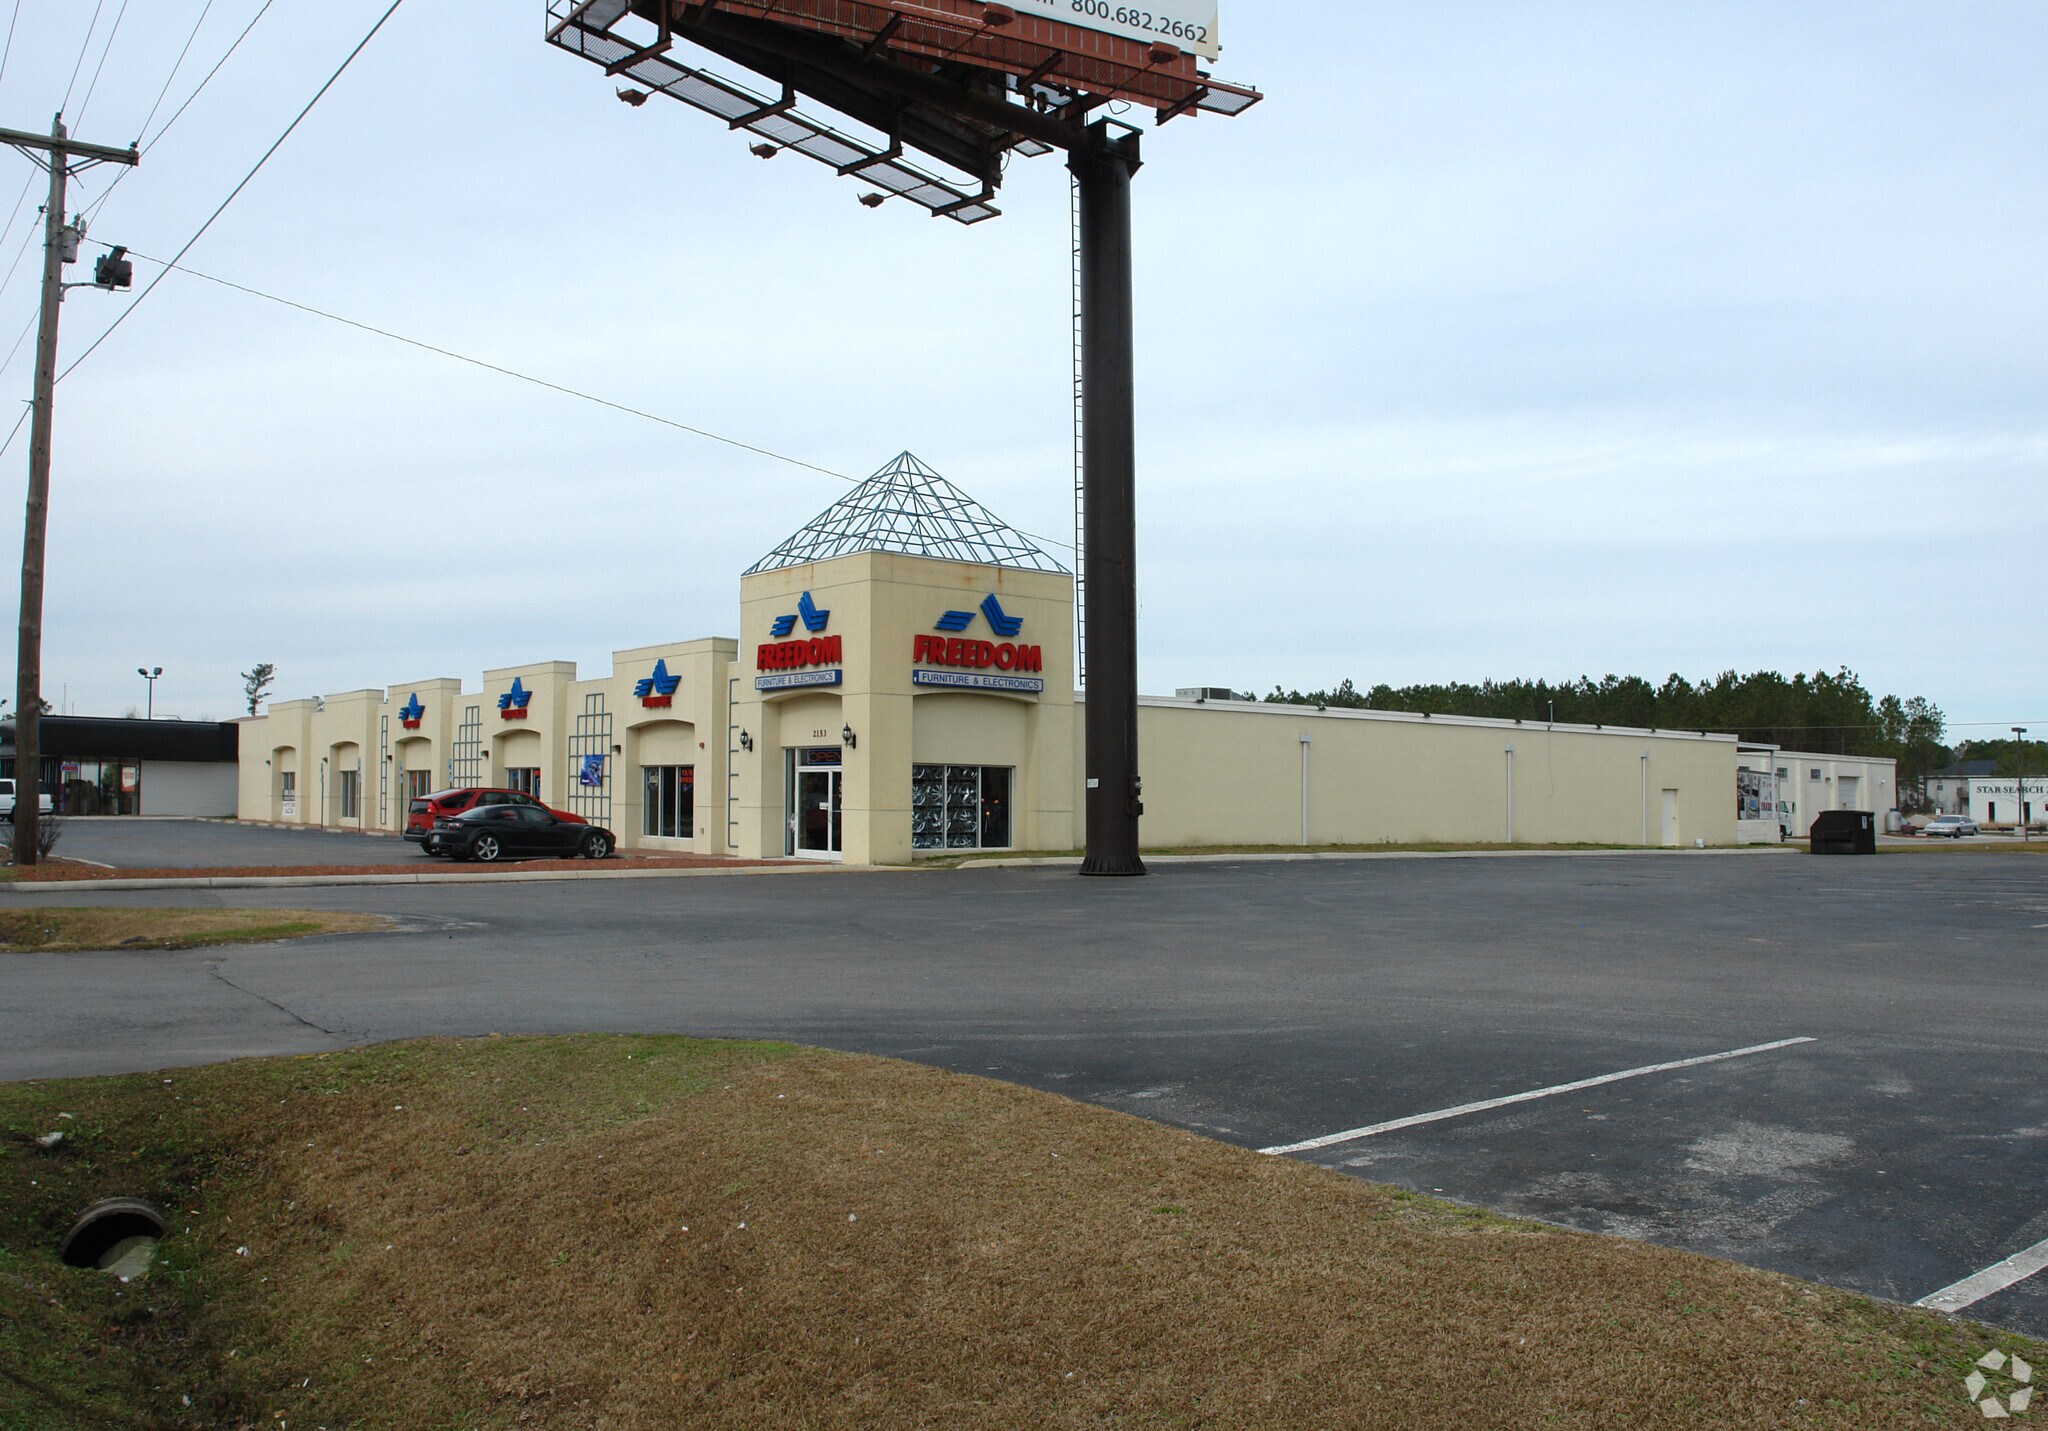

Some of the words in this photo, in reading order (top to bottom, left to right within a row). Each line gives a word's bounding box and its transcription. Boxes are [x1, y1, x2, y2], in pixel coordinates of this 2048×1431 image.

[1071, 0, 1208, 44] 800.682.2662
[757, 635, 842, 671] FREEDOM
[913, 634, 1042, 672] FREEDOM
[757, 676, 786, 688] FURNITURE
[794, 672, 833, 684] ELECTRONICS
[922, 672, 969, 685] FURNITURE
[973, 677, 979, 685] &
[983, 677, 1039, 690] ELECTRONICS
[812, 729, 827, 738] 2153
[1976, 786, 2001, 794] STAR
[2003, 786, 2043, 794] SEARCH
